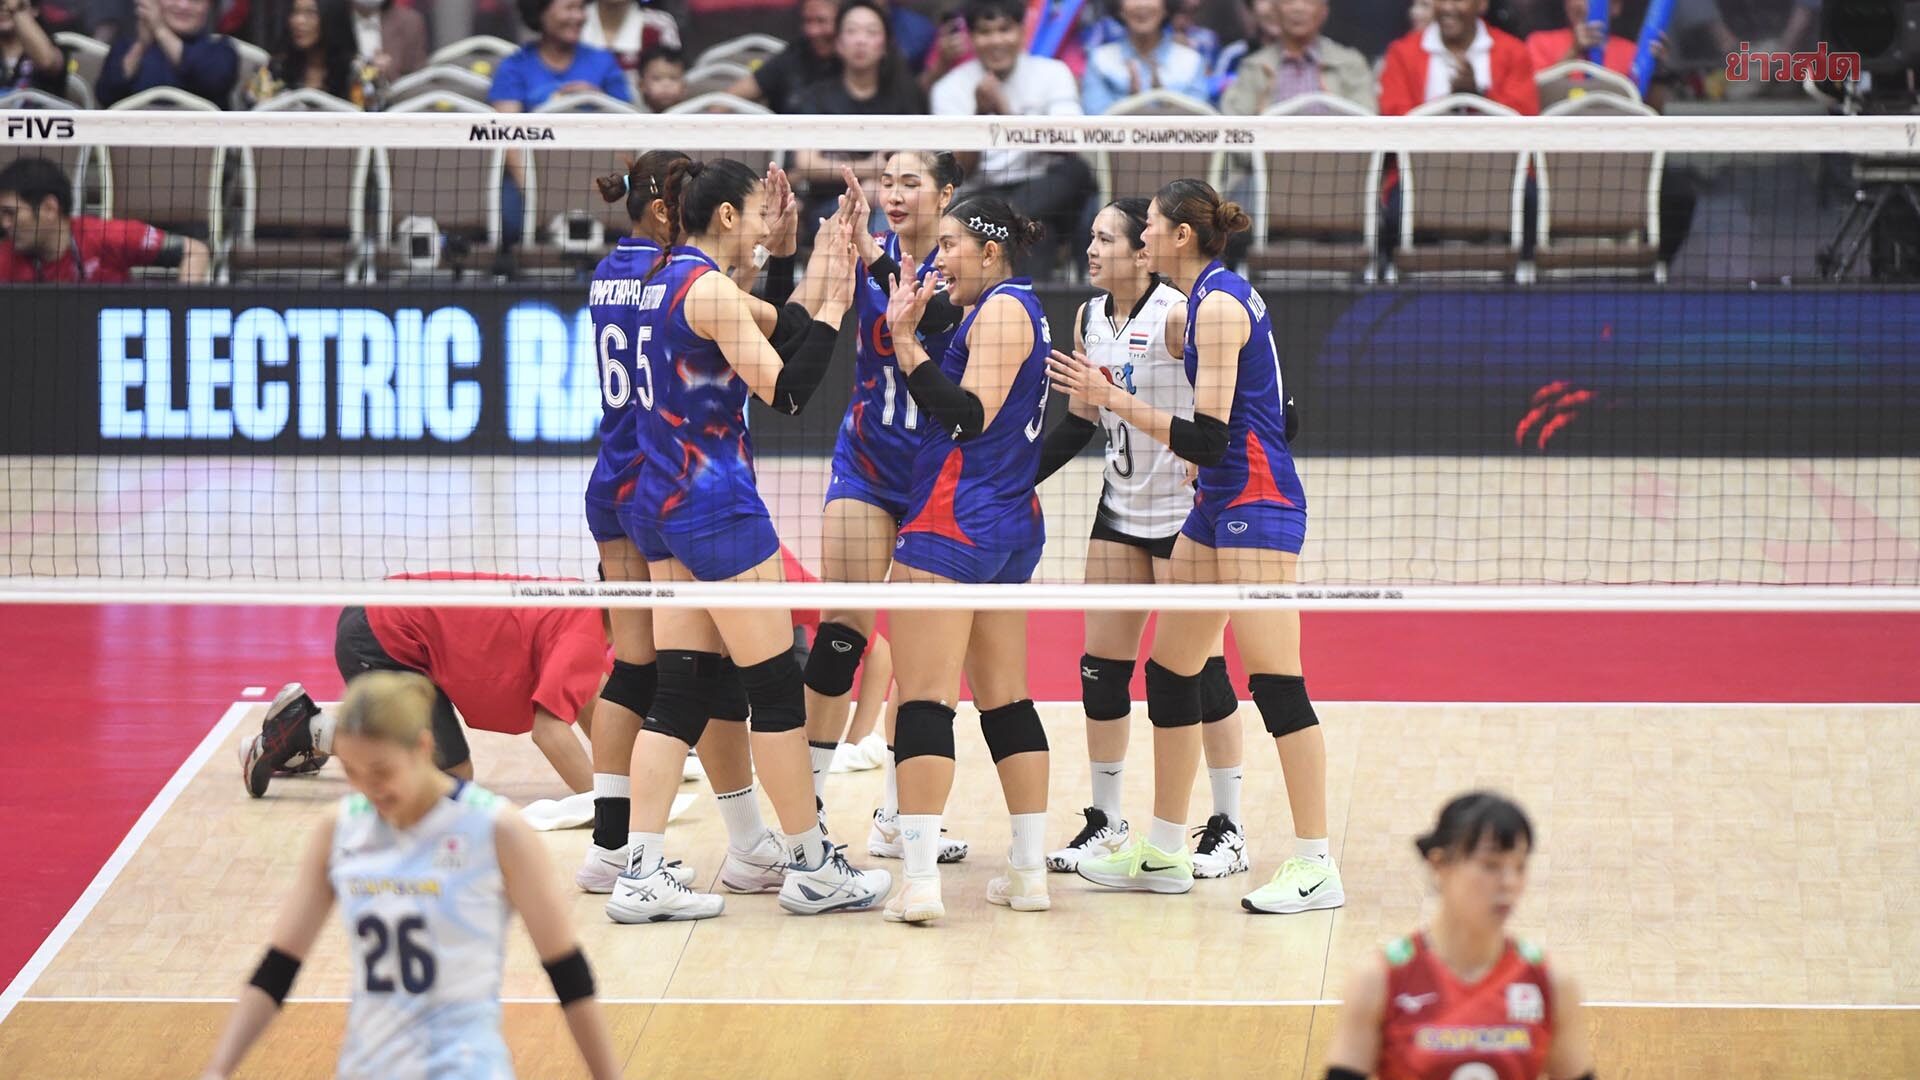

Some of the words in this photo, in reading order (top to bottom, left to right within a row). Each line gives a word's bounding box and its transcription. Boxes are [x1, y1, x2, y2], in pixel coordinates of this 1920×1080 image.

[1006, 129, 1076, 143] VOLLEYBALL
[1083, 129, 1125, 143] WORLD
[1132, 129, 1219, 143] CHAMPIONSHIP
[1225, 129, 1255, 143] 2025
[99, 307, 481, 440] ELECTRIC
[636, 326, 654, 411] 5
[356, 914, 436, 995] 26
